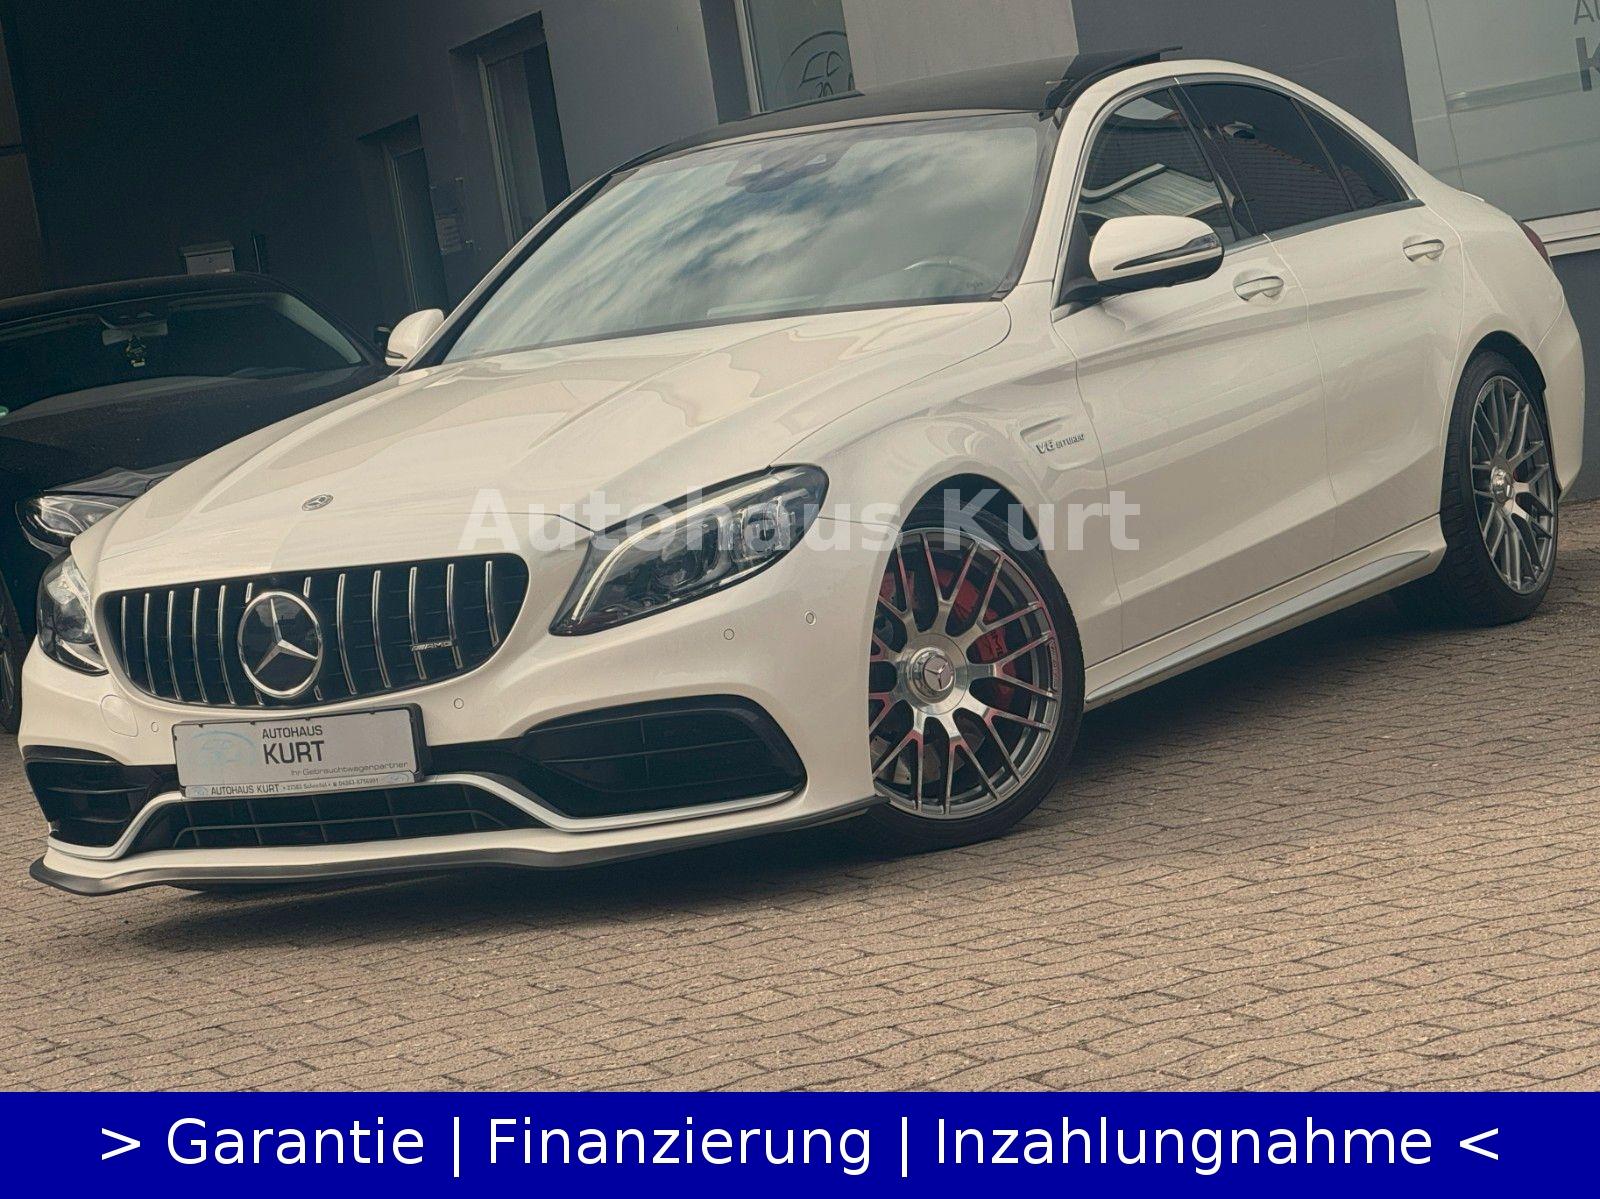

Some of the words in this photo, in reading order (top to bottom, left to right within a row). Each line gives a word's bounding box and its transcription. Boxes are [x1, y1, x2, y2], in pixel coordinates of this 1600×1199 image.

[262, 724, 323, 739] AUTOHAUS
[263, 740, 325, 765] KURT
[302, 761, 408, 776] Gebrauchtwagenpartner
[211, 785, 254, 795] AUTOHAUS
[257, 783, 280, 794] KURT
